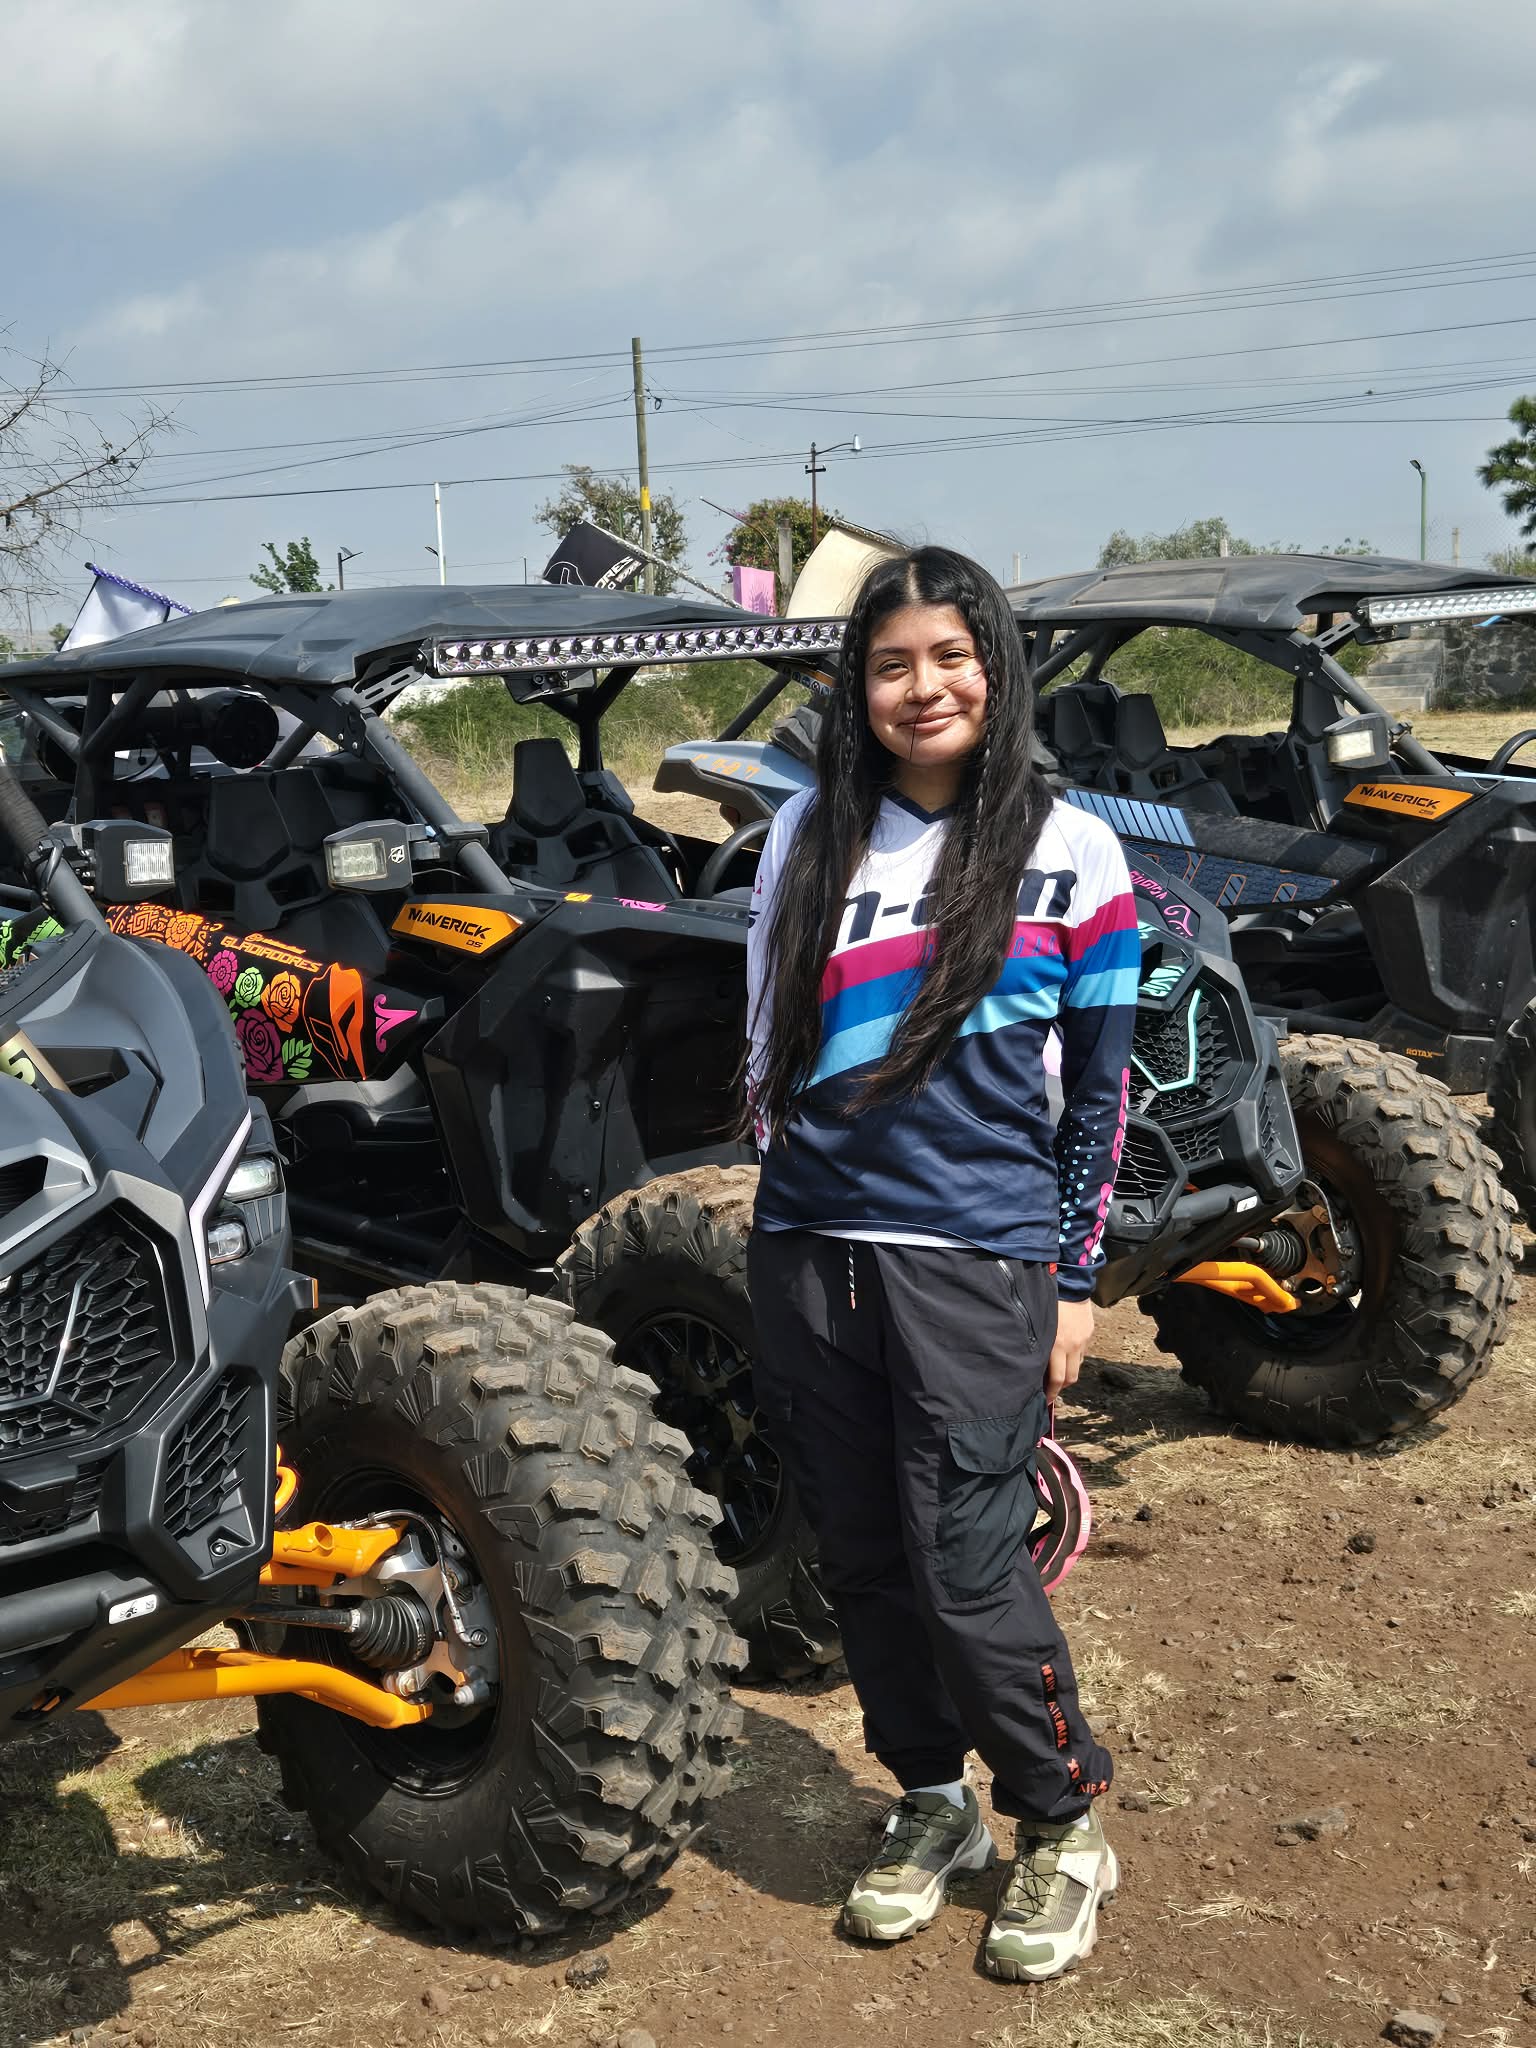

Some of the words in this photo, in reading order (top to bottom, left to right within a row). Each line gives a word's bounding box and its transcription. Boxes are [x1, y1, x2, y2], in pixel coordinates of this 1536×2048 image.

[1360, 785, 1440, 810] MAVERICK
[408, 907, 491, 940] MAVERICK
[220, 935, 323, 973] GLADIADORES
